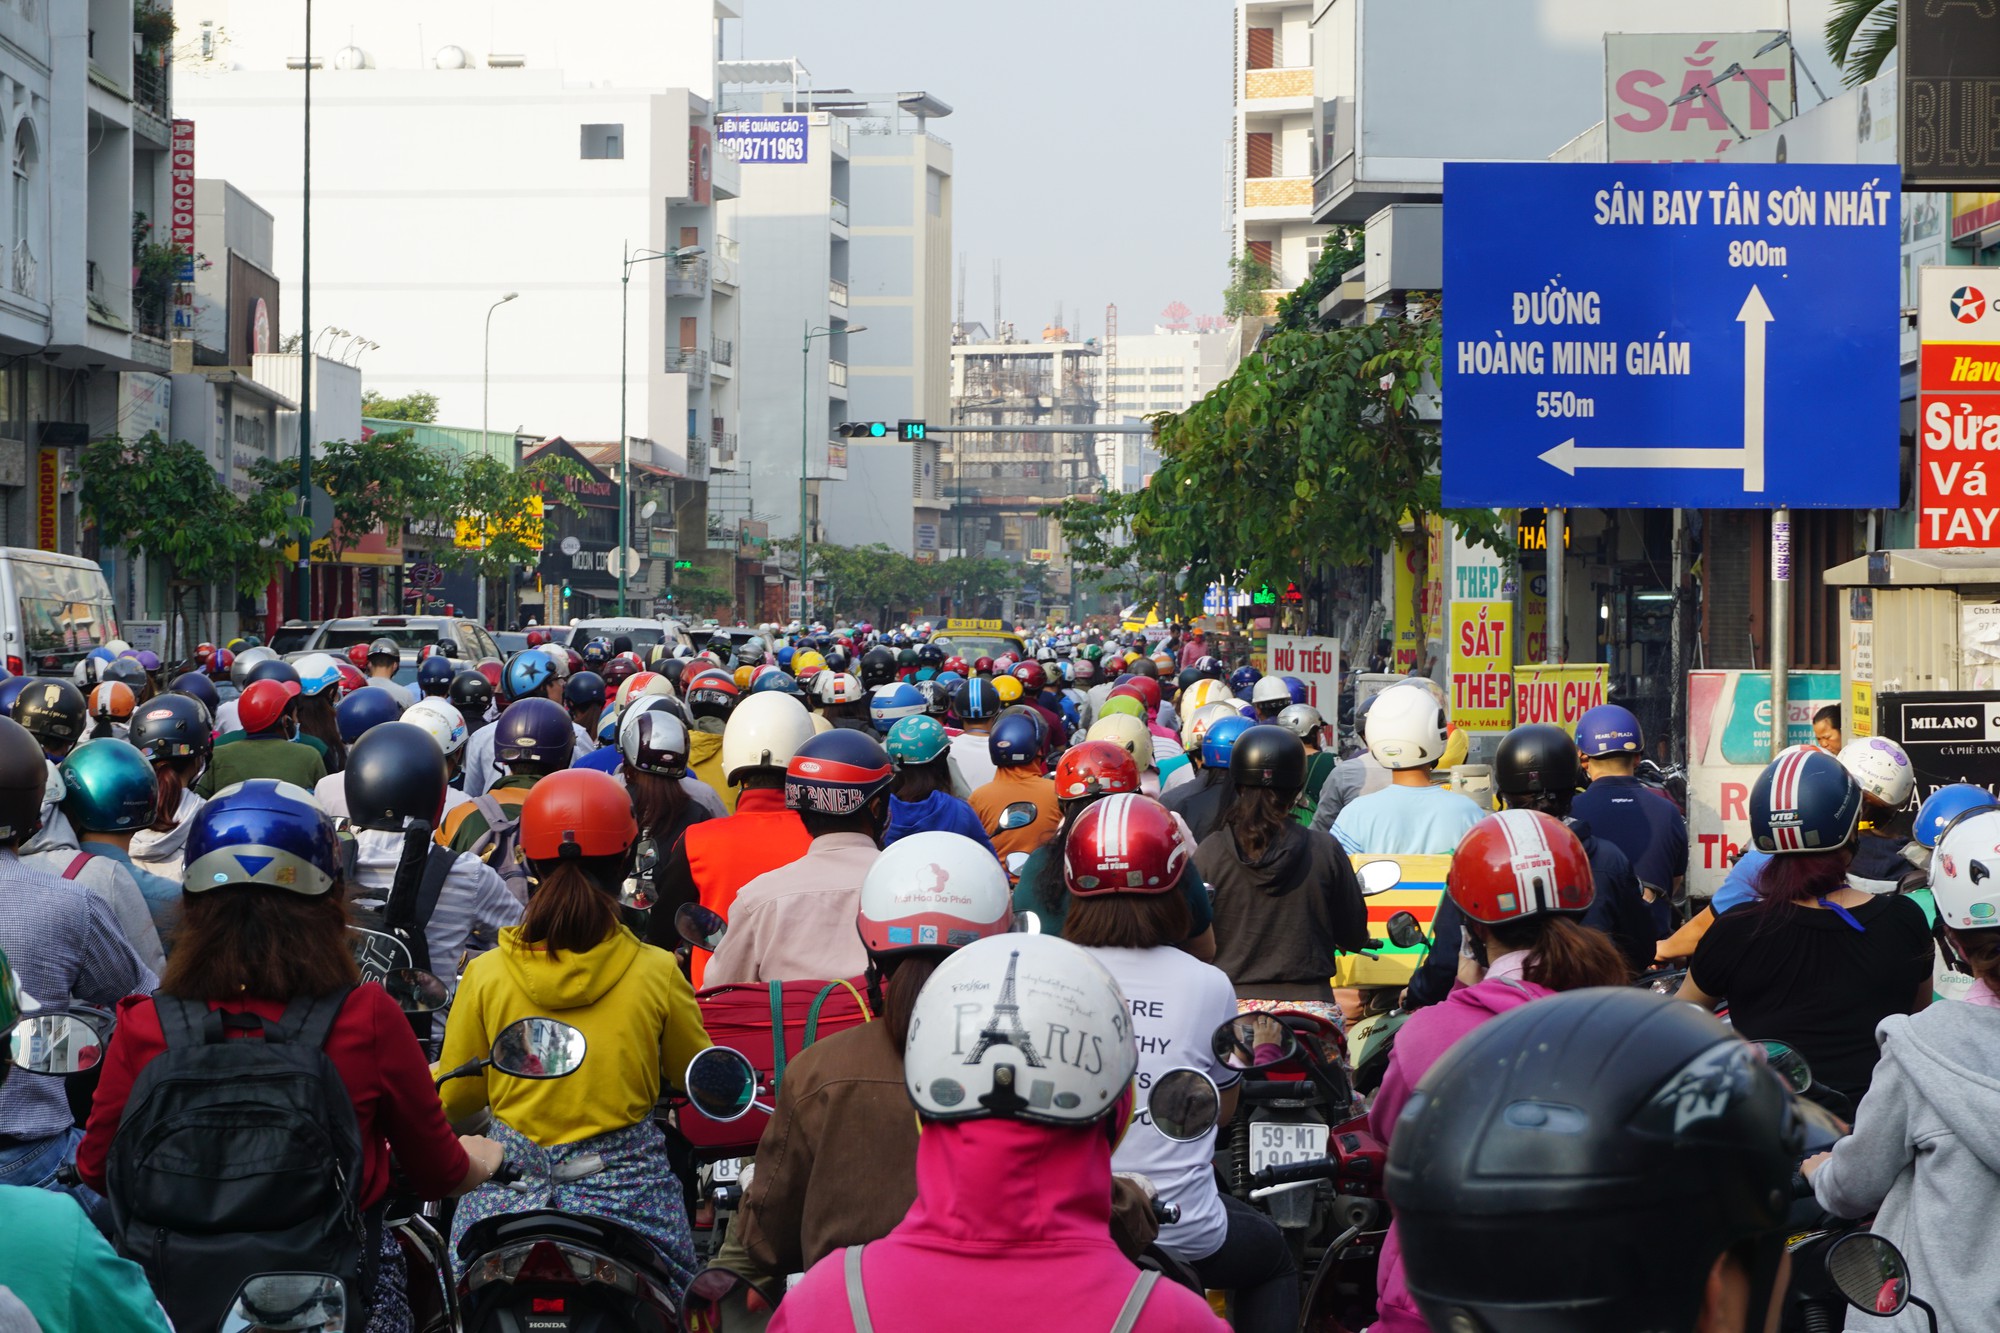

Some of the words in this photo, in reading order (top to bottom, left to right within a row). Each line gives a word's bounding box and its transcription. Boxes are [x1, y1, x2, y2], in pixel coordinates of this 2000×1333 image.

[1613, 40, 1786, 133] SẮT
[1594, 180, 1644, 226] SÂN
[1653, 190, 1703, 225] BAY
[1709, 181, 1759, 226] TÂN
[1767, 185, 1816, 226] SƠN
[1824, 178, 1891, 226] NHẤT
[1728, 239, 1787, 267] 800m
[1512, 278, 1600, 325] ĐƯỜNG
[1458, 330, 1544, 375] HOÀNG
[1552, 341, 1617, 375] MINH
[1625, 331, 1690, 375] GIÁM
[1536, 390, 1594, 418] 550m
[907, 424, 924, 439] 14
[1929, 461, 1987, 496] Vá
[41, 452, 55, 551] PHOTOCOPY
[1517, 519, 1570, 550] THÁH
[1923, 507, 2000, 541] TAY
[1456, 557, 1499, 598] THÉP
[1461, 606, 1504, 657] SẮT
[1275, 641, 1295, 671] HỦ
[1299, 643, 1332, 674] TIẾU
[1453, 663, 1511, 708] THÉP
[1517, 672, 1558, 724] BÚN
[1563, 666, 1603, 723] CHẢ
[1911, 716, 1978, 730] MILANO
[1957, 744, 1975, 754] PHÊ
[1126, 999, 1164, 1018] RE
[529, 1321, 567, 1329] HONDA
